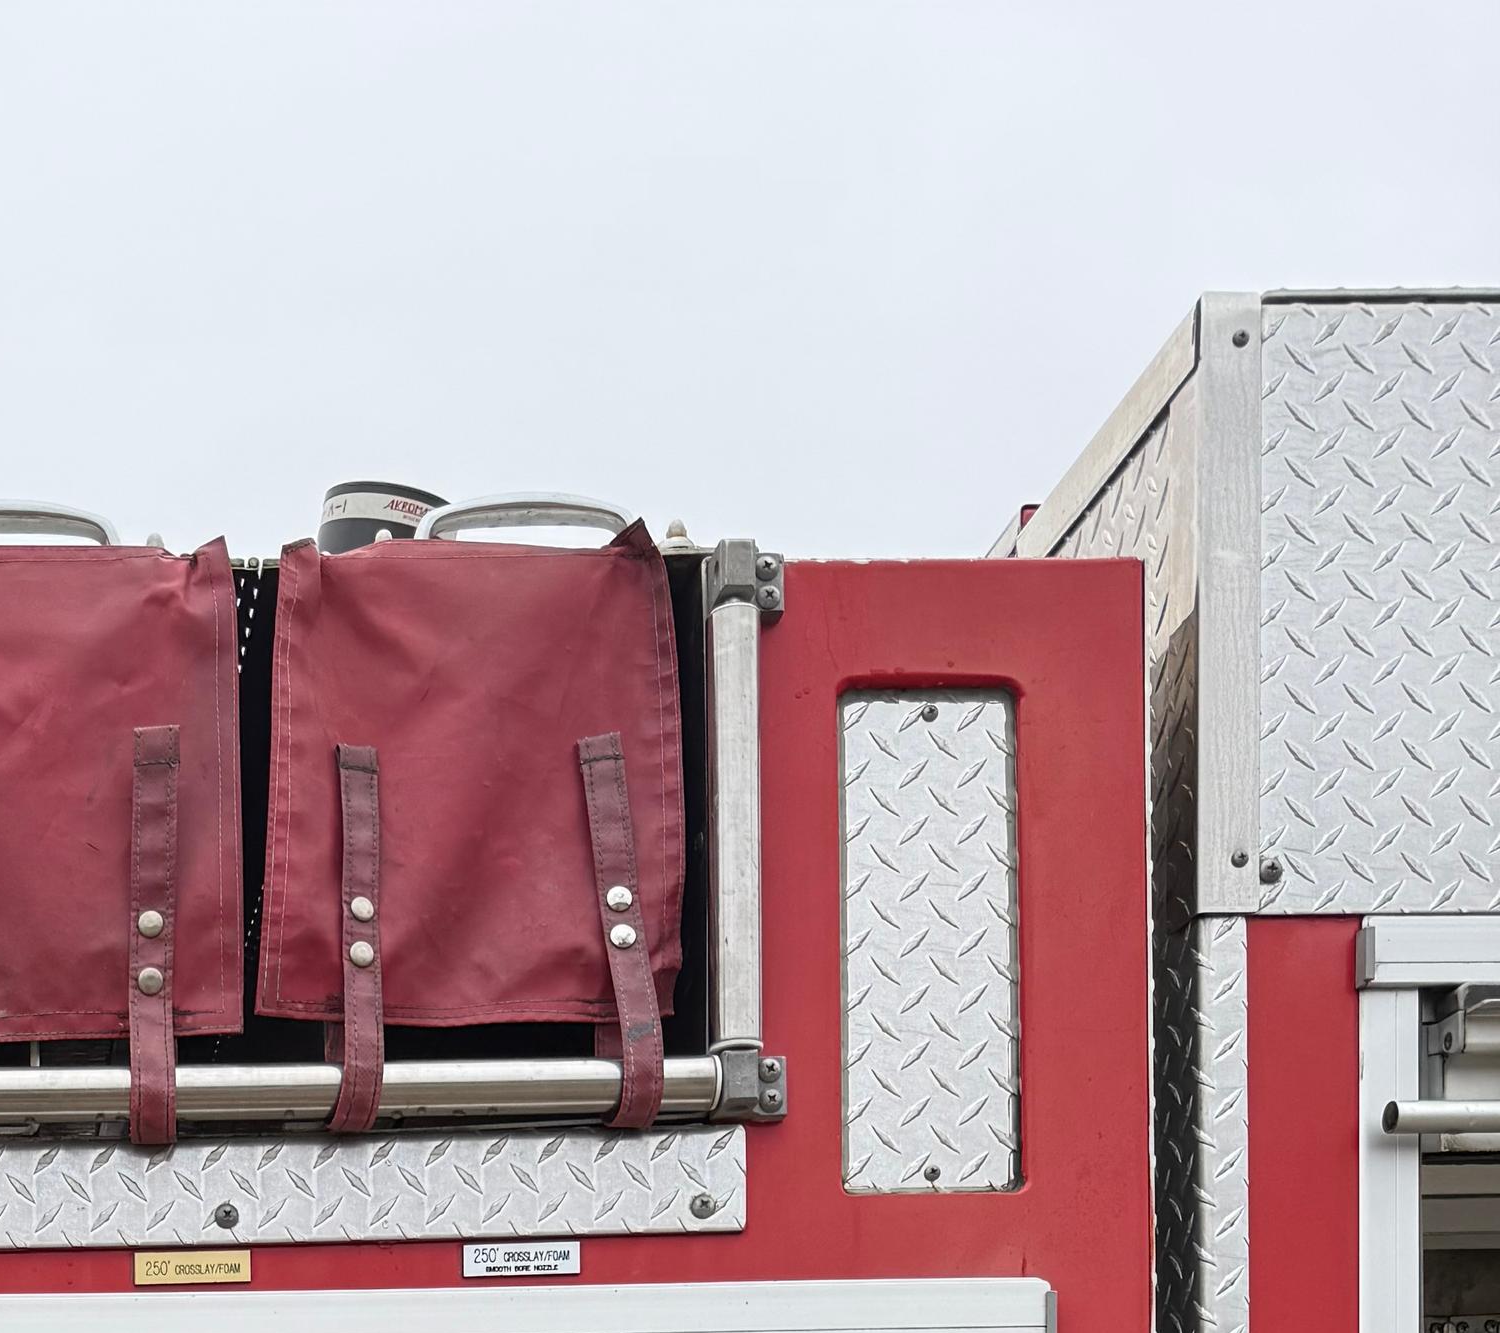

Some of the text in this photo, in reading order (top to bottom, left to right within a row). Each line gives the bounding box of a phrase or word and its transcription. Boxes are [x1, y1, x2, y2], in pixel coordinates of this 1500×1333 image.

[474, 1247, 570, 1263] 250' CROSSLAY/FOAM
[145, 1260, 241, 1276] 250' CROSSLAY/FOAM
[485, 1265, 512, 1273] SMOOTH
